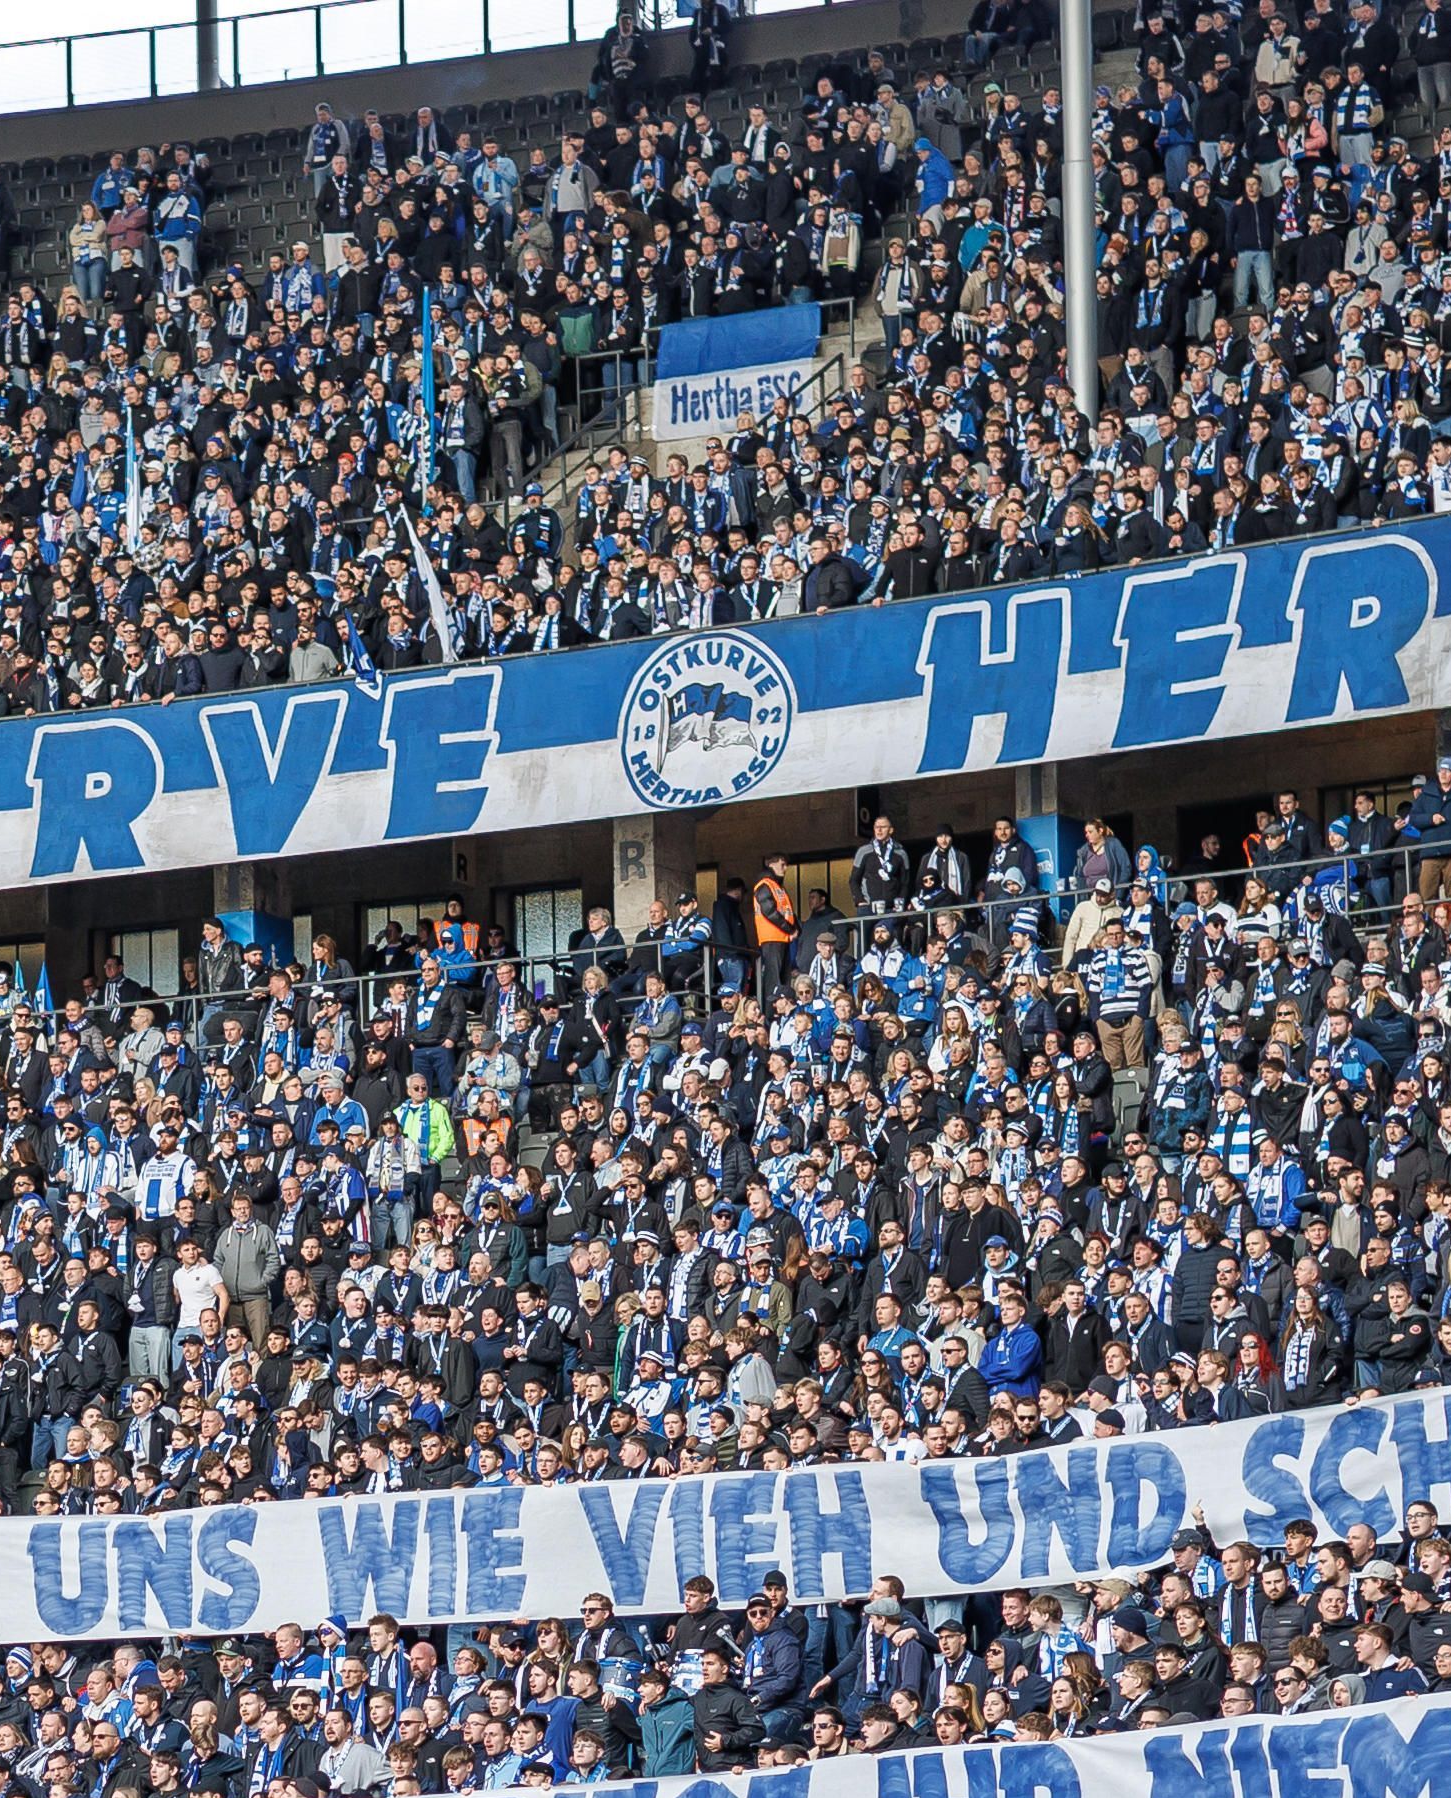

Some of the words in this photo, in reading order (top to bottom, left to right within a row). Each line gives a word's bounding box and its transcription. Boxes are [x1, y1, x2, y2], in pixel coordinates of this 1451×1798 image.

[671, 377, 753, 425] Hertha
[639, 641, 779, 712] OSTKURVE
[633, 724, 655, 742] 18
[756, 706, 782, 724] 92
[630, 750, 723, 804] HERTHA
[731, 736, 779, 792] BSC
[618, 840, 647, 882] R
[27, 1503, 260, 1634] UNS
[317, 1485, 527, 1626] WIE
[577, 1469, 876, 1606] VIEH
[919, 1441, 1189, 1587] UND
